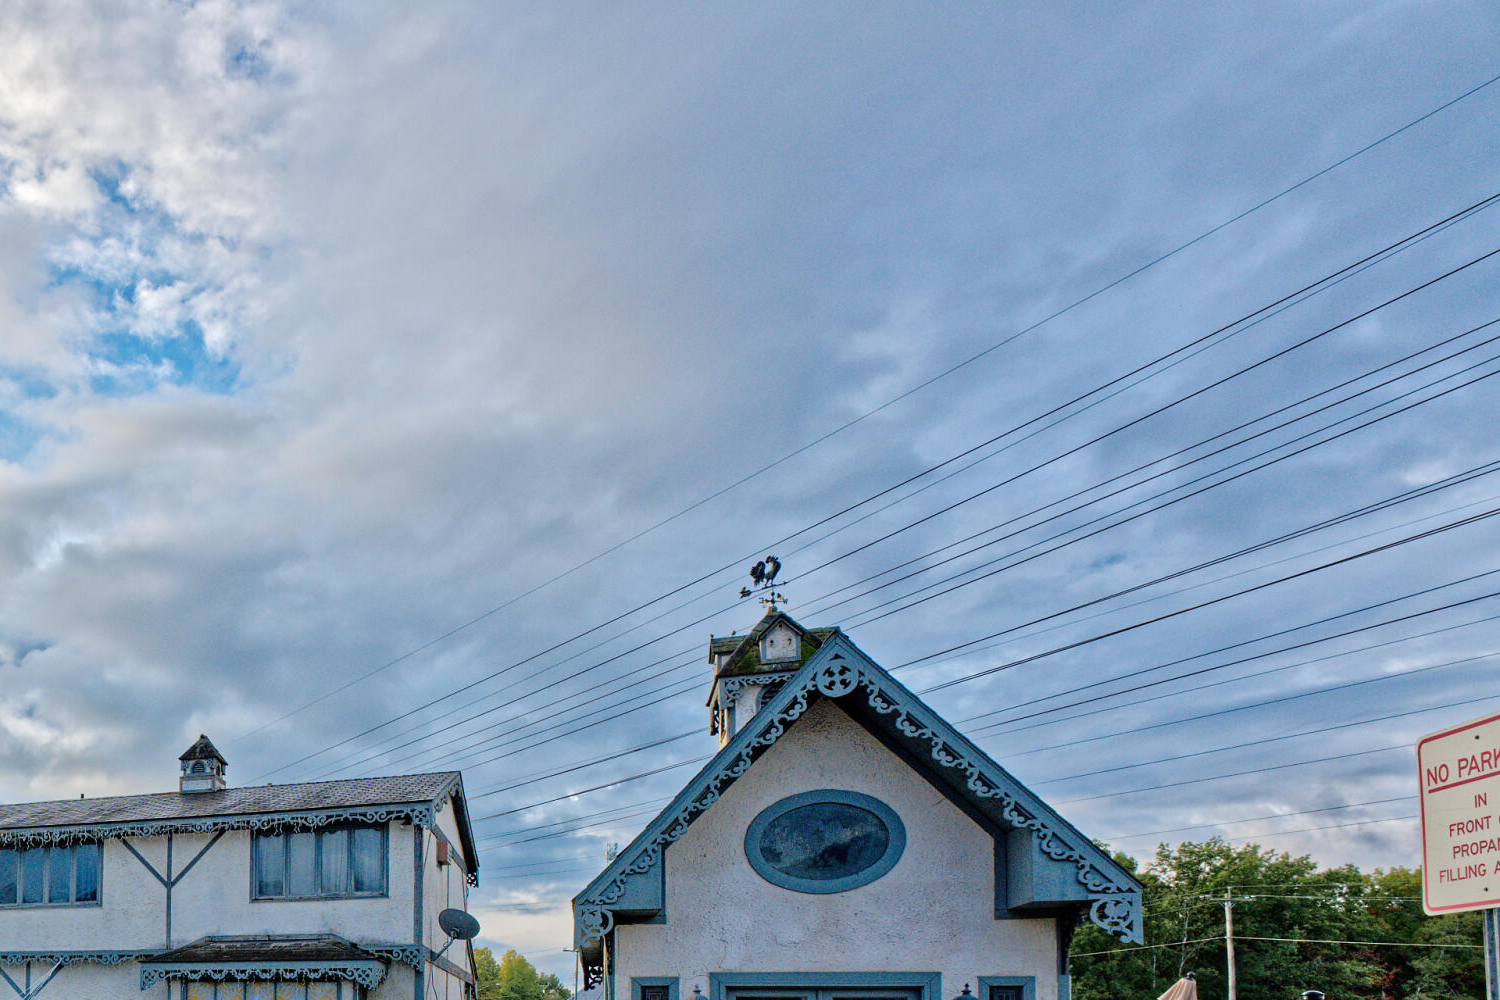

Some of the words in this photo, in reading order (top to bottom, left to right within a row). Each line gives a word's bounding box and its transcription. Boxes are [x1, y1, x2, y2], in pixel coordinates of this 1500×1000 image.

[1427, 764, 1449, 787] NO
[1474, 793, 1487, 808] IN
[1449, 816, 1492, 838] FRONT
[1439, 863, 1487, 883] FILLING
